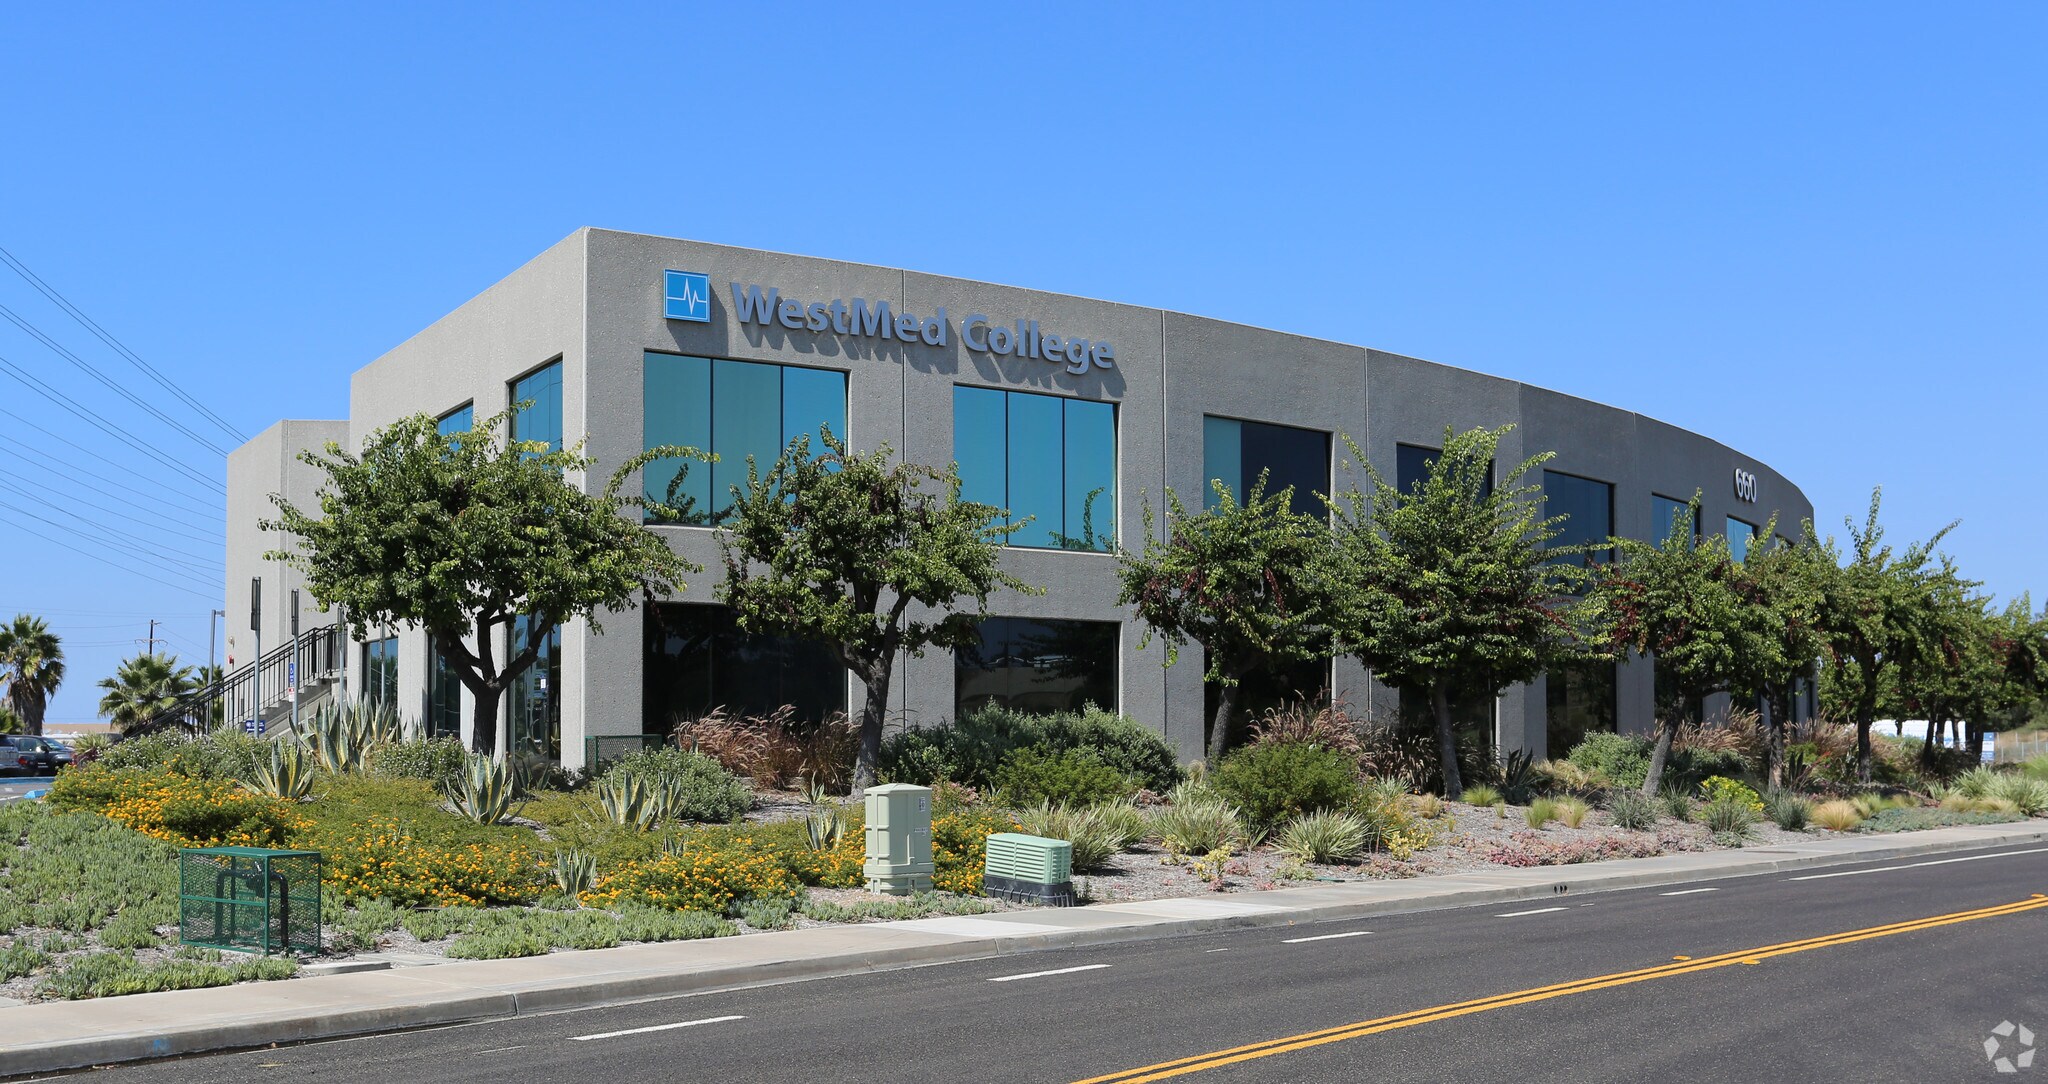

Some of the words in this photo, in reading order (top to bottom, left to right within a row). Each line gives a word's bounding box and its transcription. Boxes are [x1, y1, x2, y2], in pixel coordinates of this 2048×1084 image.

[730, 281, 948, 347] WestMed
[961, 313, 1115, 375] College
[1735, 468, 1757, 503] 660
